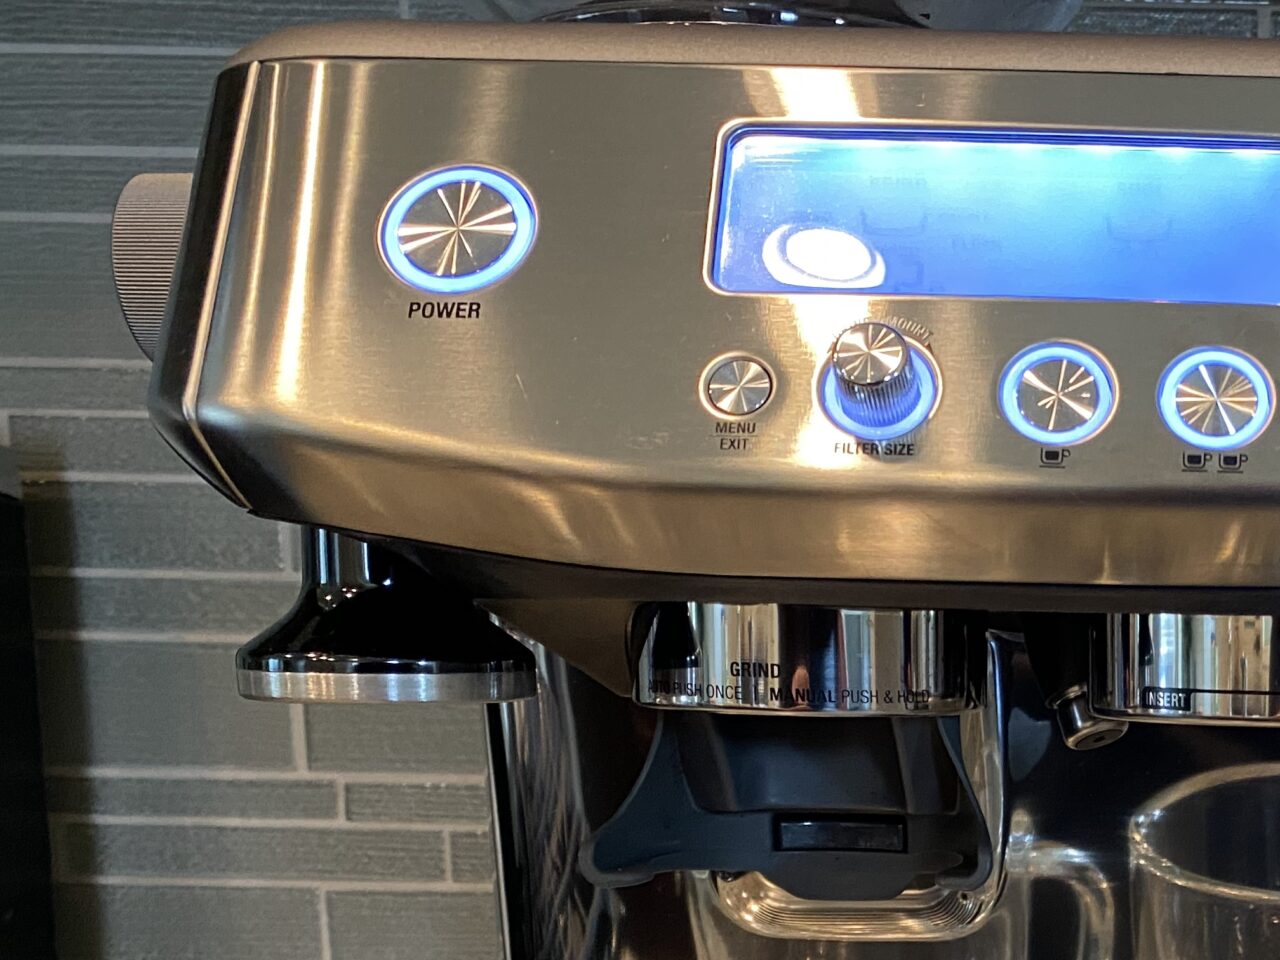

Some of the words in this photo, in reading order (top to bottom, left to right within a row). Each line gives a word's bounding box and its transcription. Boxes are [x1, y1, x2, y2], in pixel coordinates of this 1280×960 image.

[408, 302, 481, 319] POWER
[715, 422, 757, 434] MENU
[719, 438, 750, 450] EXIT
[834, 442, 880, 455] FILTER
[884, 443, 915, 456] SIZE
[730, 661, 781, 678] GRIND
[673, 681, 702, 697] PUSH
[706, 684, 743, 700] ONCE
[769, 687, 836, 704] MANUAL
[841, 689, 878, 704] PUSH
[883, 689, 893, 703] &
[897, 688, 930, 704] HOLD
[1145, 691, 1186, 708] INSERT
